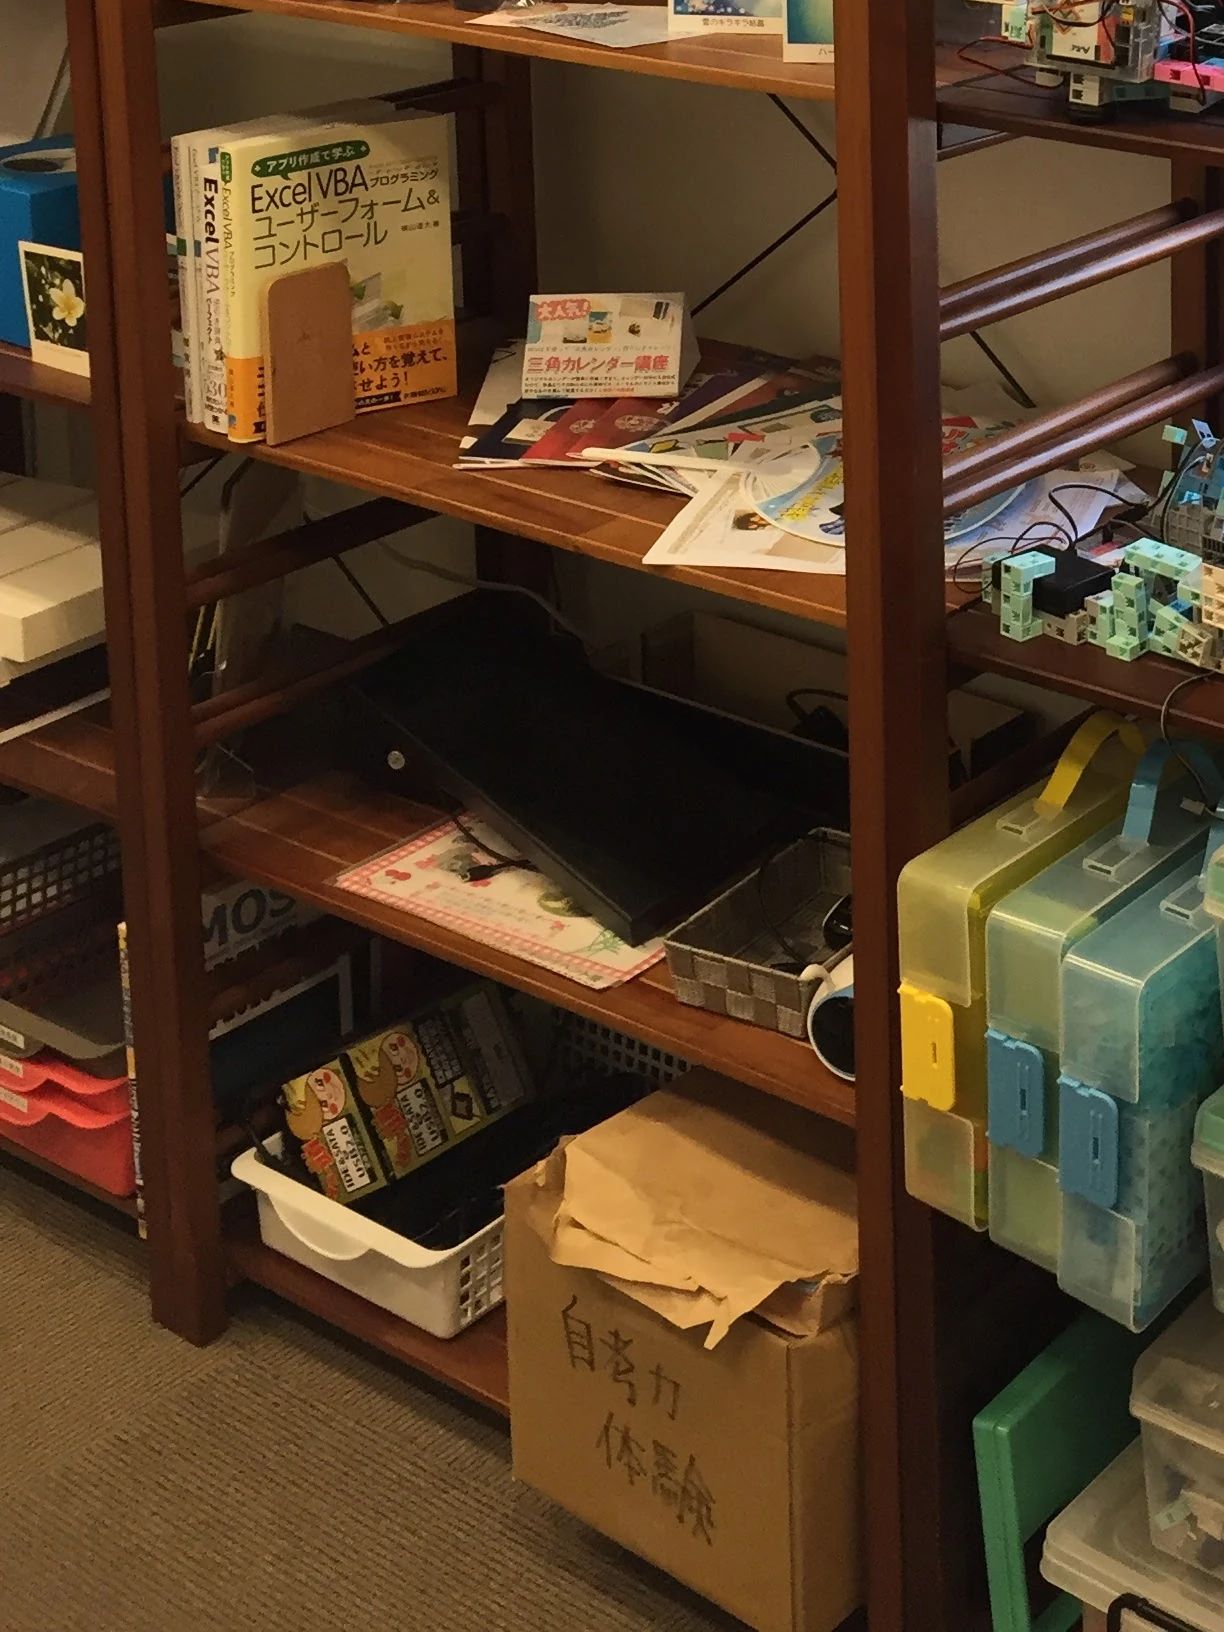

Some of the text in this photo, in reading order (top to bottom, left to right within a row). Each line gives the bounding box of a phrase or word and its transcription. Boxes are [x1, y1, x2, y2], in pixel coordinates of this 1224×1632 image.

[267, 145, 355, 172] アプリ作成で学ぶ
[251, 164, 369, 213] Excel VBA
[370, 168, 438, 188] プログラミング
[203, 177, 219, 244] Excel
[255, 221, 388, 270] コントロール
[205, 247, 220, 294] VBA
[353, 371, 409, 393] せよう！
[527, 354, 670, 374] 三角カレンダー講座
